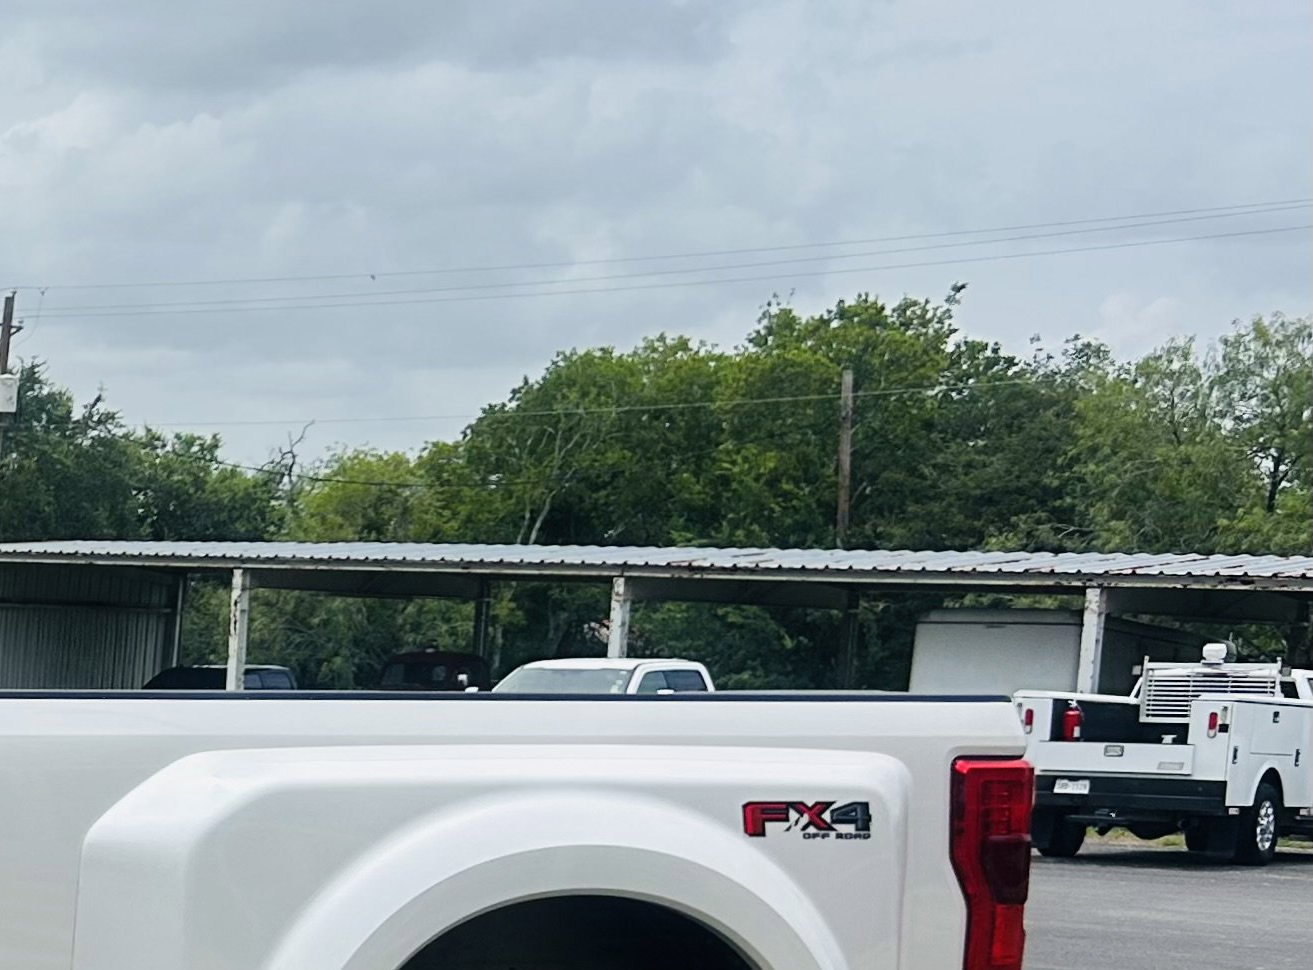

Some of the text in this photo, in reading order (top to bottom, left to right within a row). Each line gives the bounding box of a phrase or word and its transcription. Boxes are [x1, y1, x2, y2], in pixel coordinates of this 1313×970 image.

[741, 800, 872, 837] FX4
[802, 832, 872, 840] OFF ROAD
